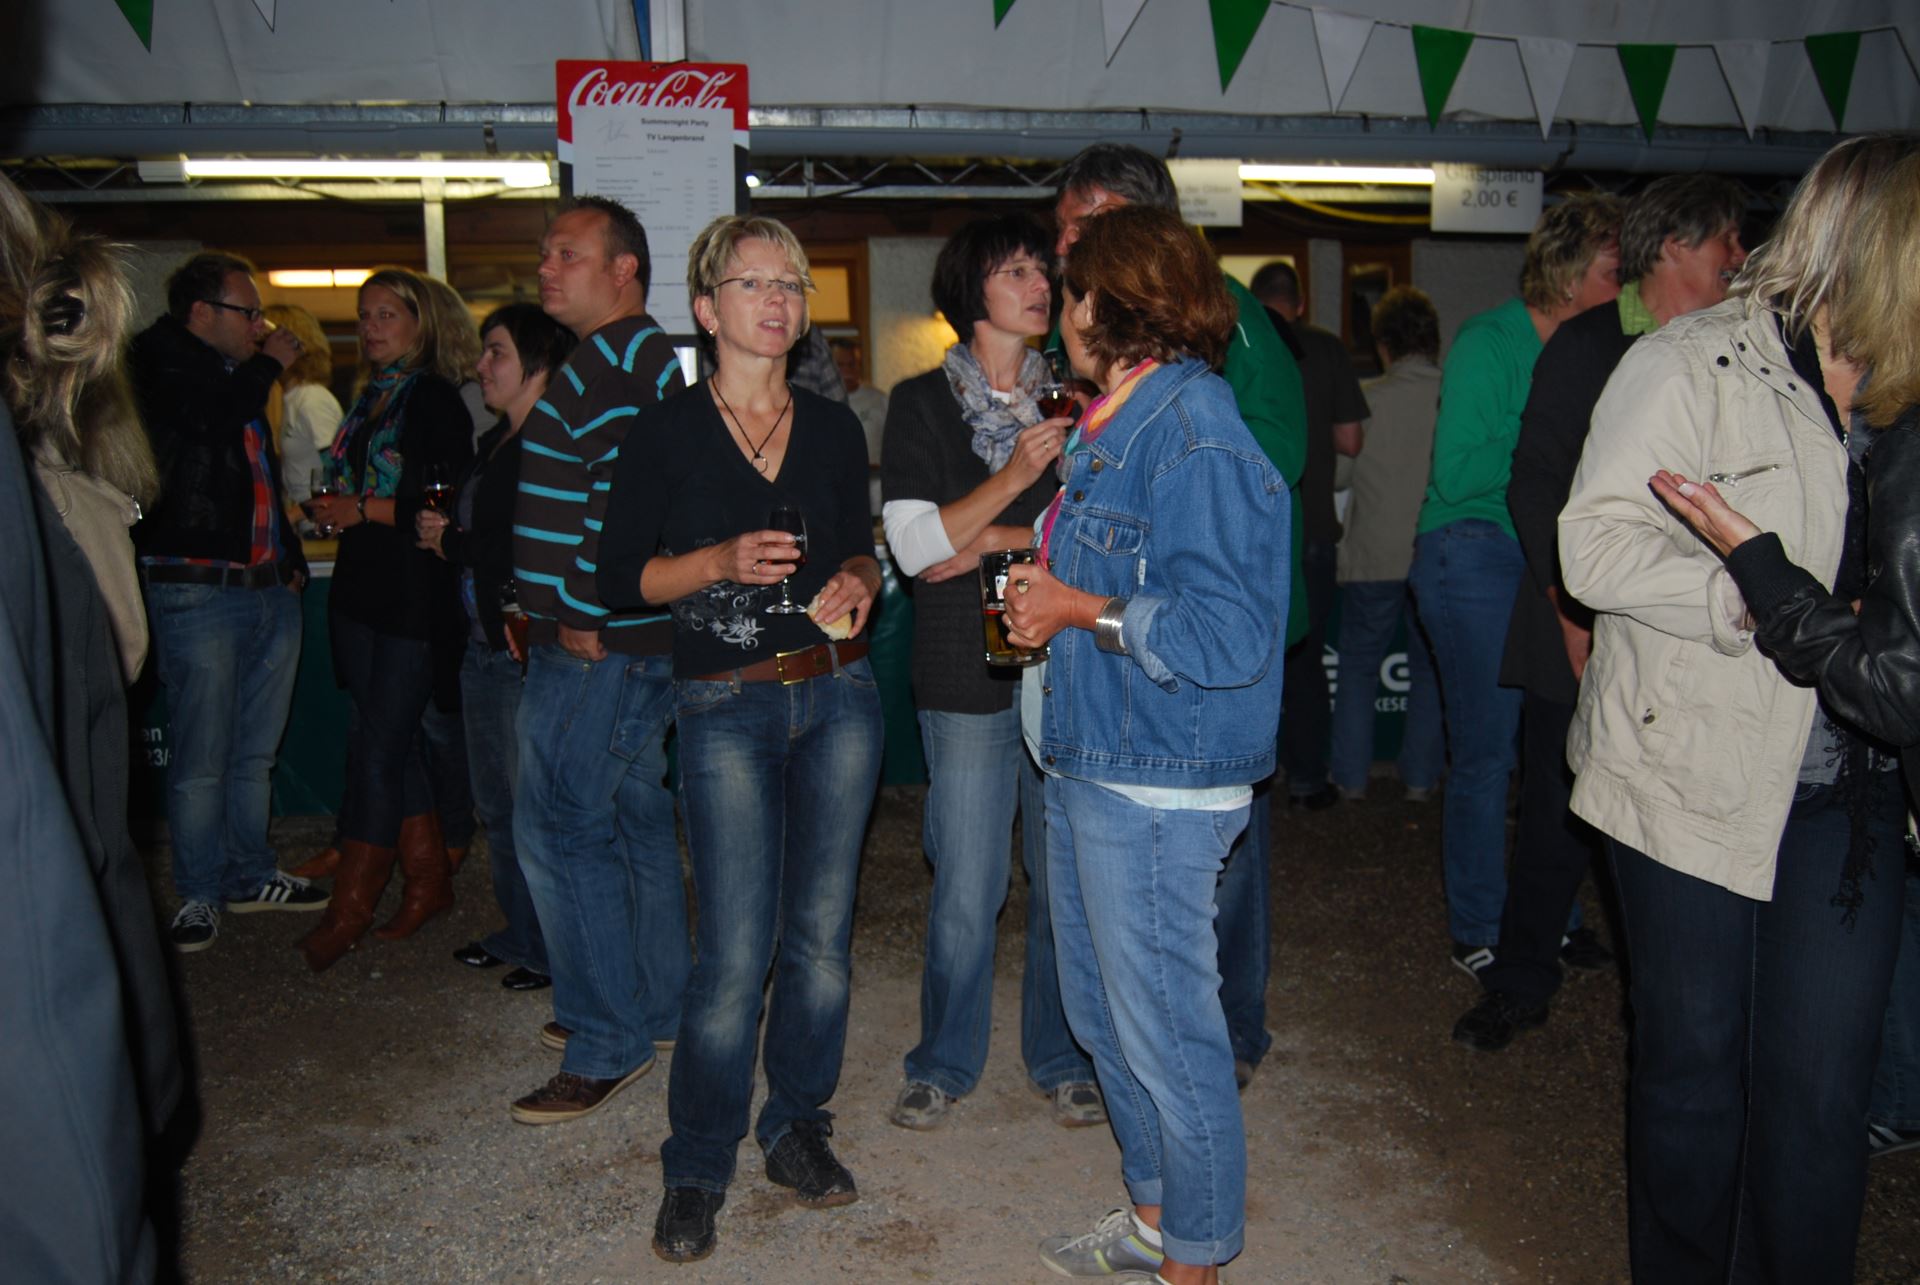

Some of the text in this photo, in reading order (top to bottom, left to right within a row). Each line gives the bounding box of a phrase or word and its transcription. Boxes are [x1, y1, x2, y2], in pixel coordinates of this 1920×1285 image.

[568, 68, 736, 109] Coca-Cola
[690, 119, 709, 128] Party
[647, 133, 705, 143] TV Langenbrand
[1461, 189, 1518, 208] 2,00 €
